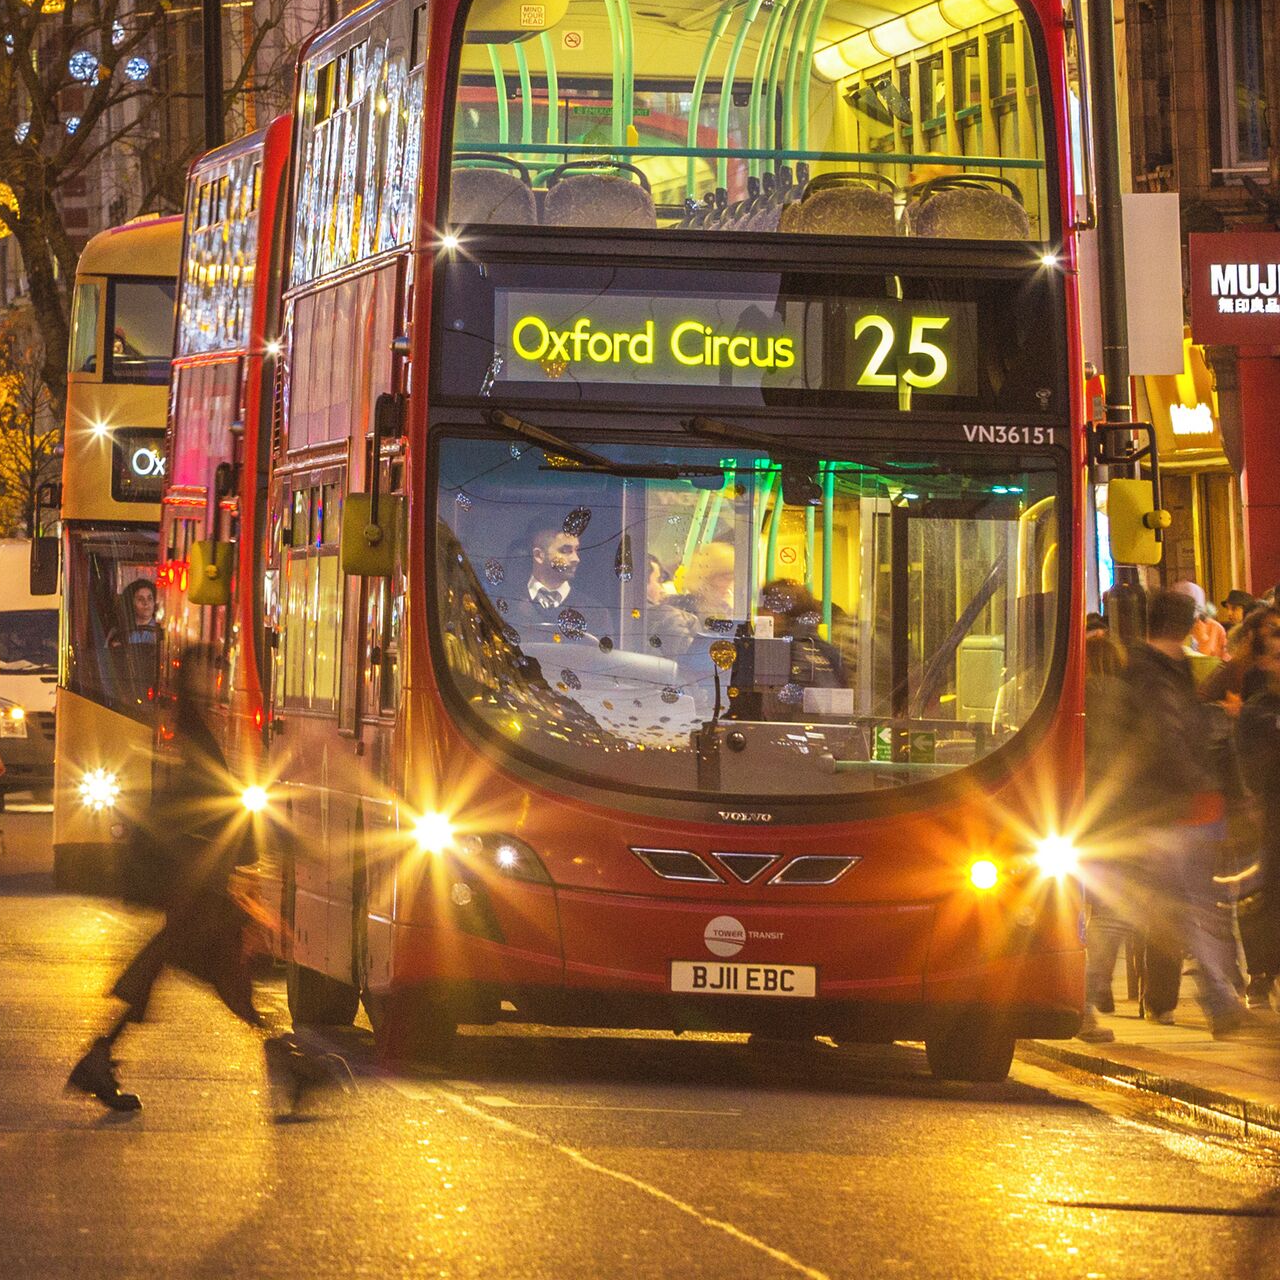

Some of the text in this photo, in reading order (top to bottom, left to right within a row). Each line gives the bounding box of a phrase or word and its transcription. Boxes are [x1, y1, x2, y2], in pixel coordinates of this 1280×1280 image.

[1210, 264, 1280, 296] MUJ
[512, 316, 795, 368] Oxford Circus
[853, 314, 950, 388] 25
[962, 424, 1055, 445] VN36151
[718, 811, 772, 822] VOLVO
[713, 929, 785, 940] TOWER TRANSIT
[746, 968, 795, 992] EBC
